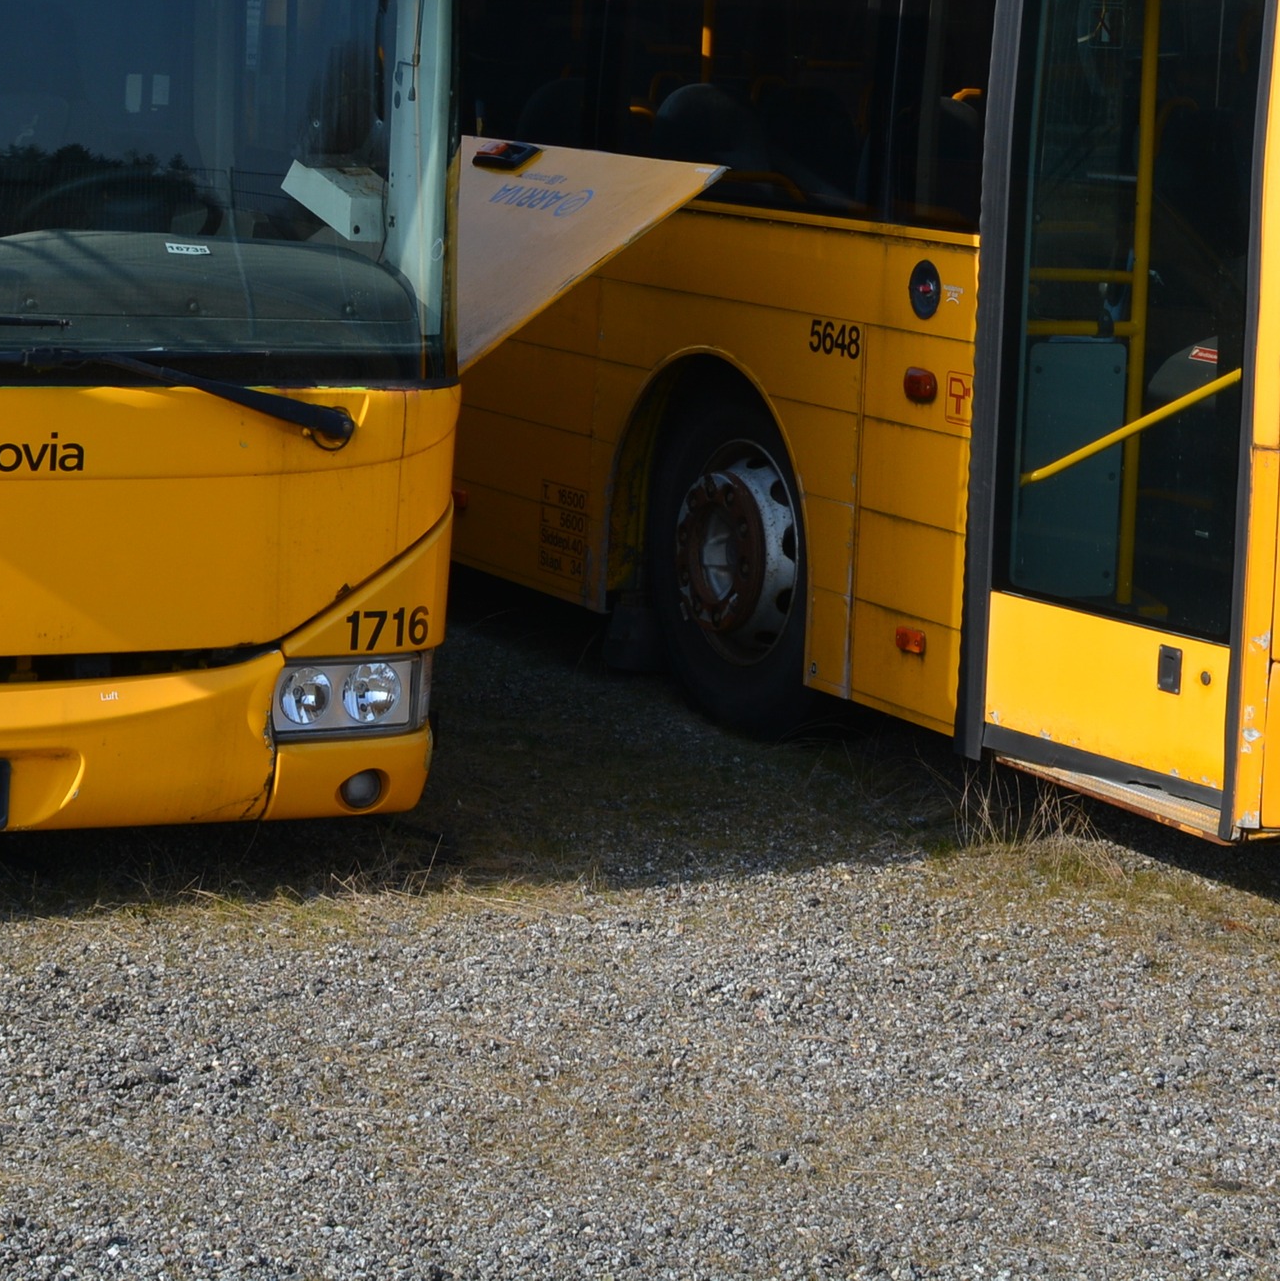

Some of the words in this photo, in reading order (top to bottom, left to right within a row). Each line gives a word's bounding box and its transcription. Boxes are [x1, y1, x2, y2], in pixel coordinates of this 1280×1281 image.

[809, 319, 860, 359] 5648
[558, 488, 585, 509] 16500
[560, 512, 584, 532] 5600
[346, 605, 429, 651] 1716
[100, 692, 119, 702] Luft
